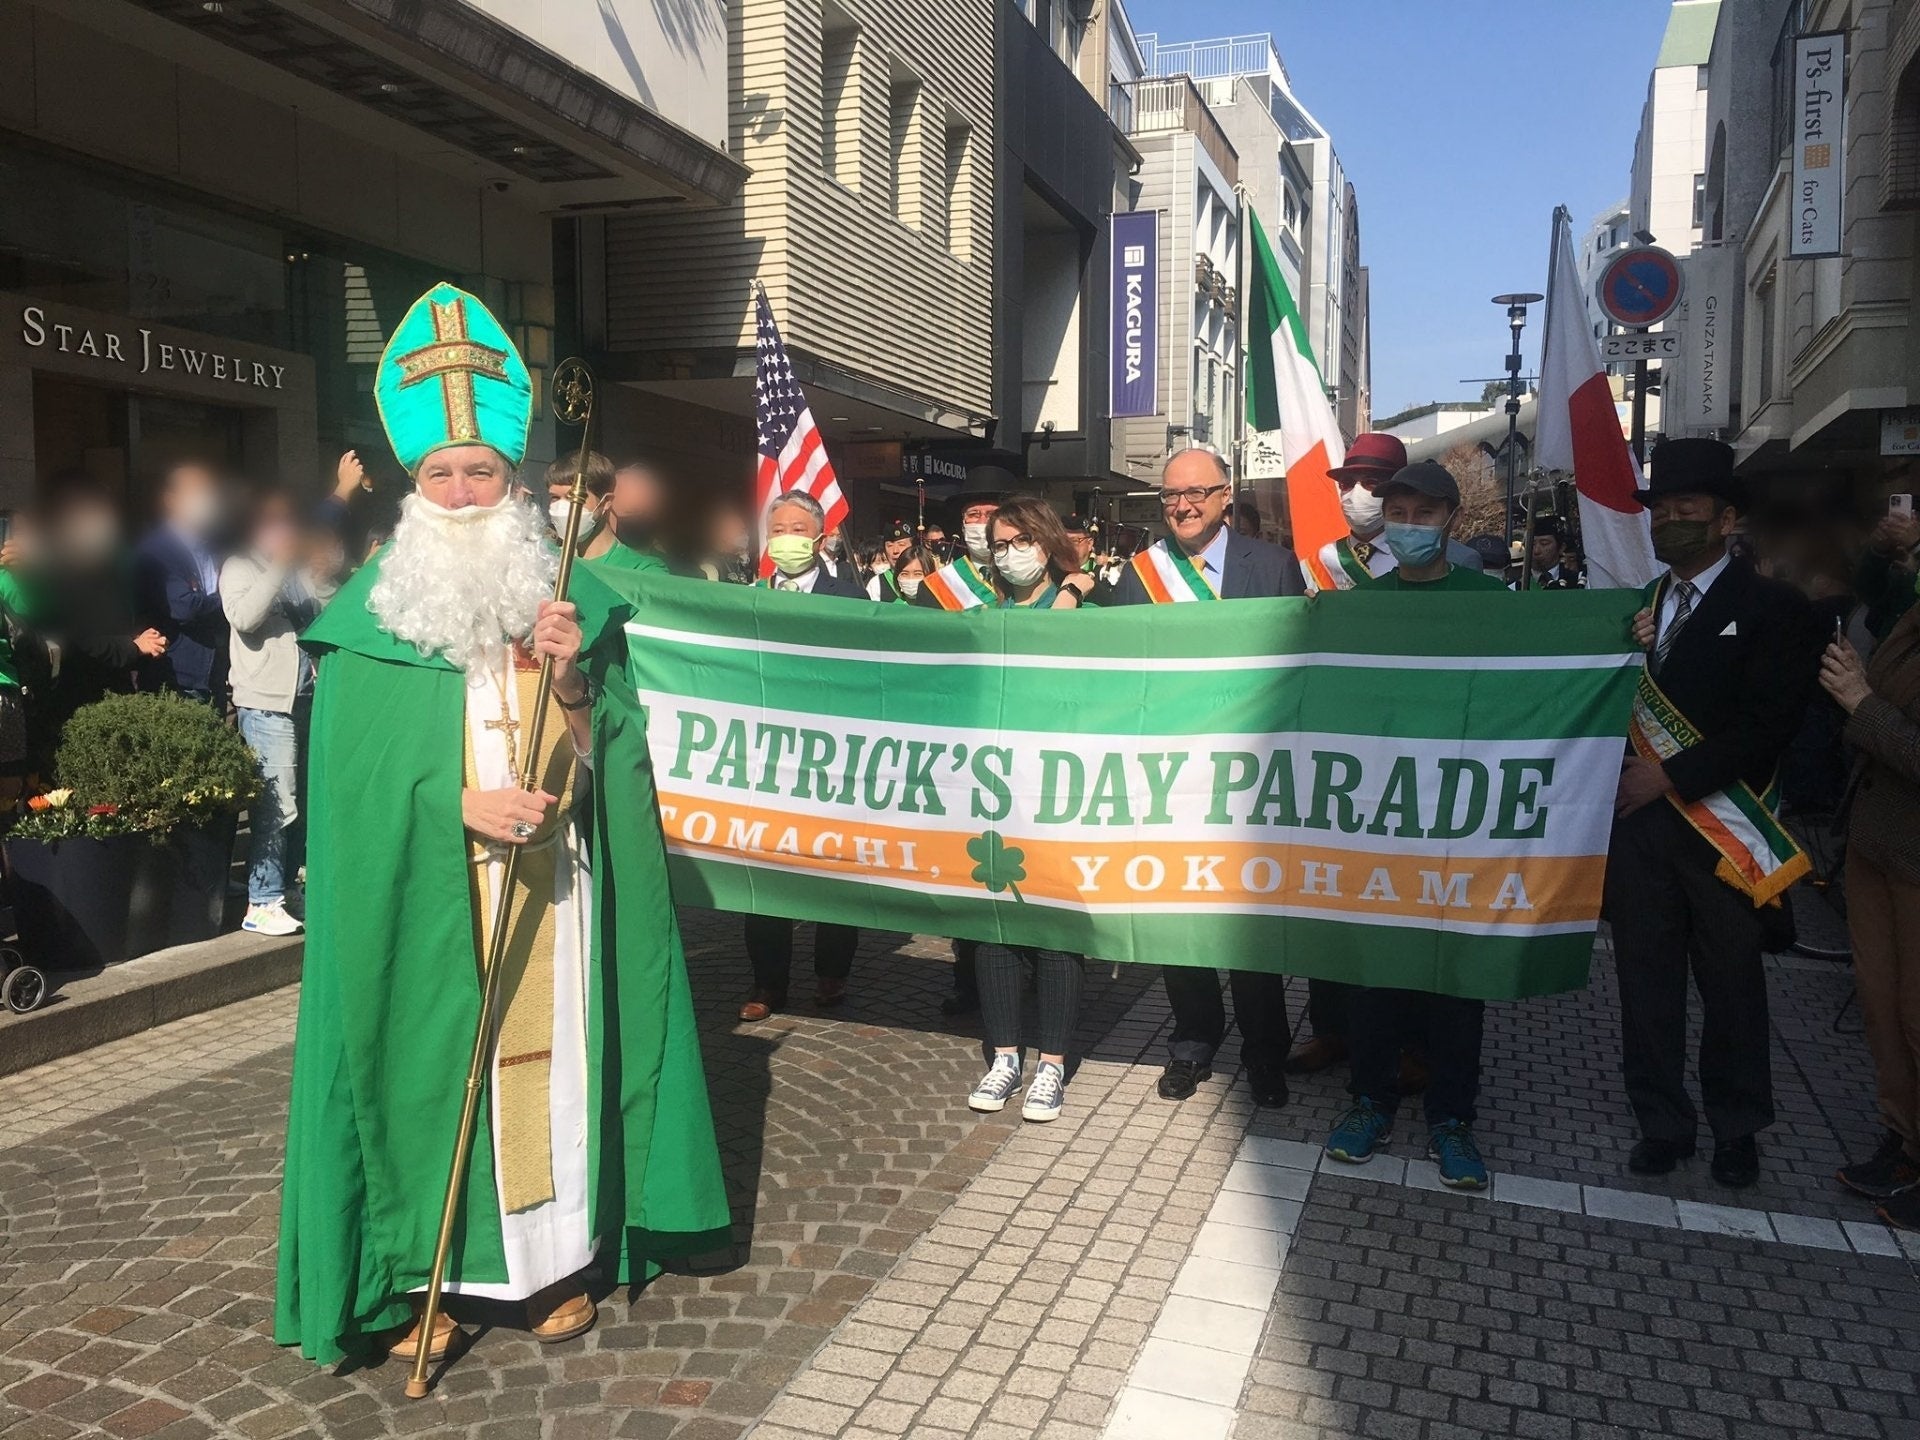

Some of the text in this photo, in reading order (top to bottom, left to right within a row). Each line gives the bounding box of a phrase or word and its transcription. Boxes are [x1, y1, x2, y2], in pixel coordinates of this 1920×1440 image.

[1804, 47, 1832, 140] P's-first
[1801, 179, 1819, 245] for Cats
[23, 306, 285, 389] STAR JEWELRY
[1126, 274, 1142, 385] KAGURA
[1607, 337, 1676, 355] ここまで
[933, 458, 967, 481] KAGURA
[668, 710, 1556, 840] PATRICK'S DAY PARADE
[1072, 854, 1534, 911] YOKOHAMA
